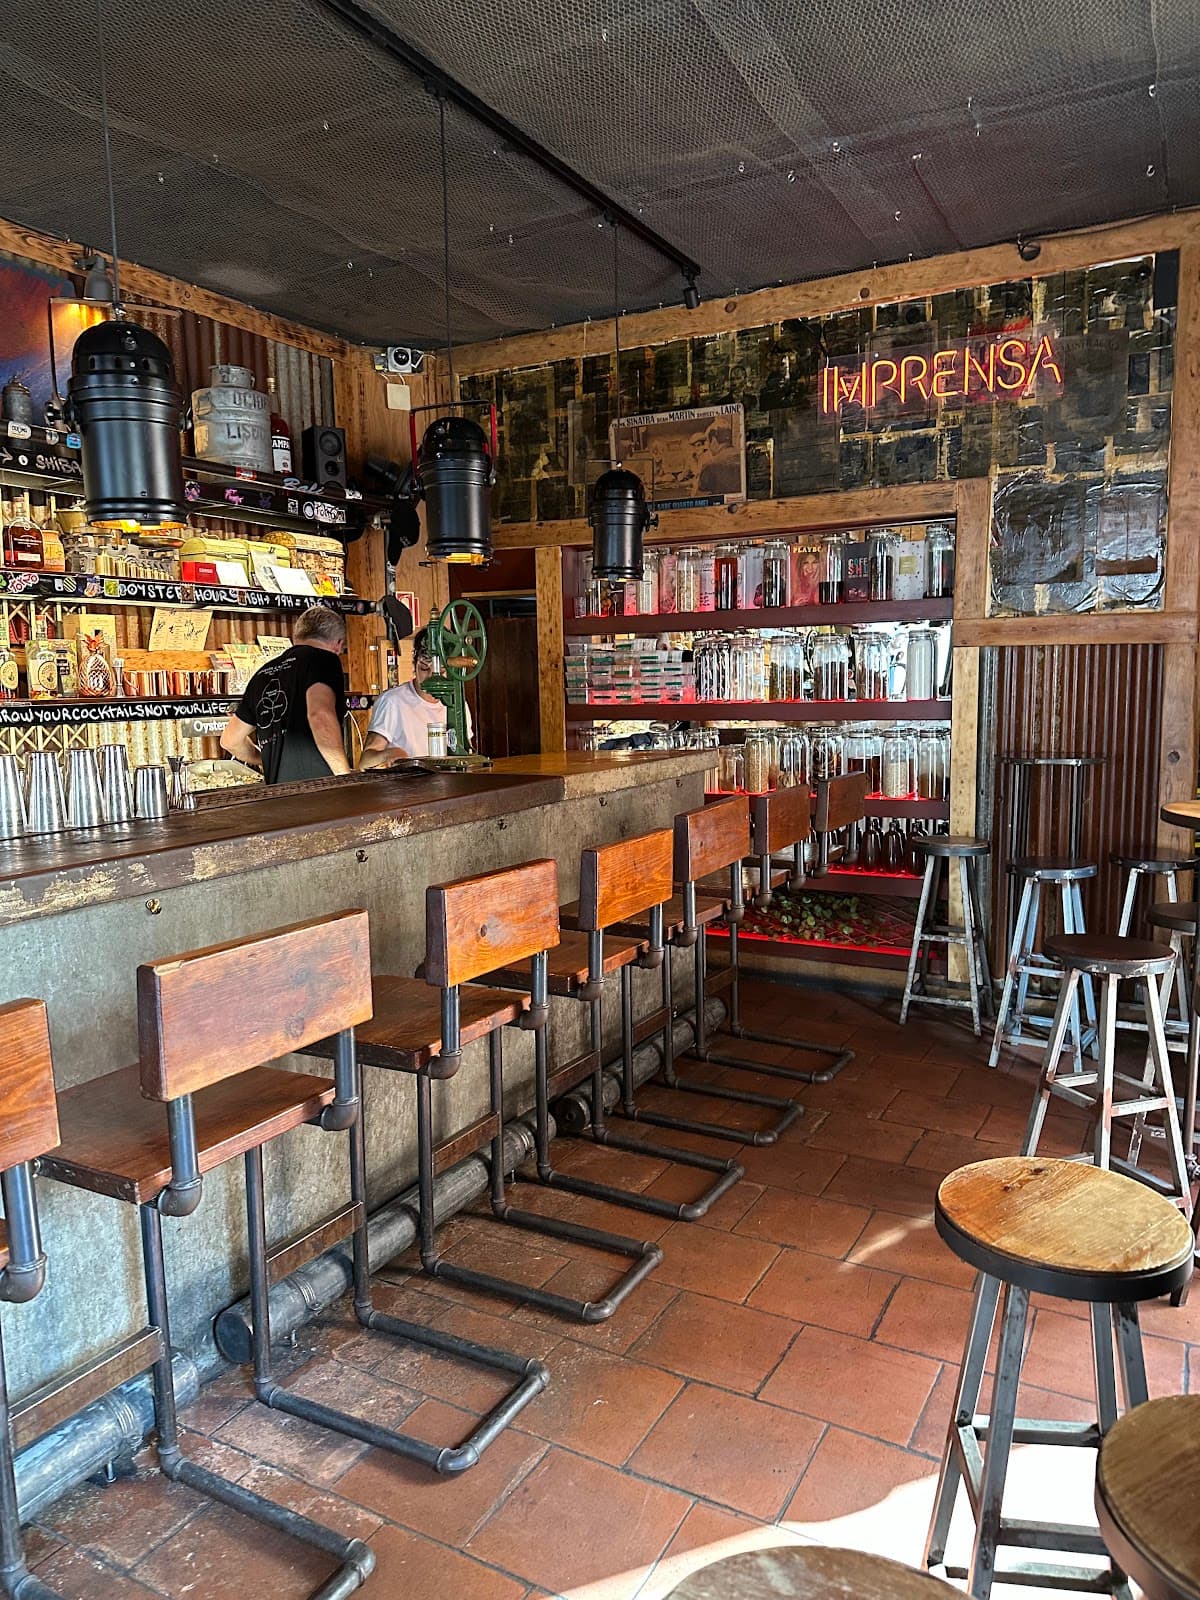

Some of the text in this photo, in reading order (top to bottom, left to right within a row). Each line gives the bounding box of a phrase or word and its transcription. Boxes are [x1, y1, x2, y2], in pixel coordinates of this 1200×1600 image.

[823, 336, 1062, 413] IMPRENSA
[626, 414, 655, 427] SINATRA
[668, 410, 696, 421] MARTIN
[275, 595, 293, 608] 19H
[144, 704, 172, 717] NOT
